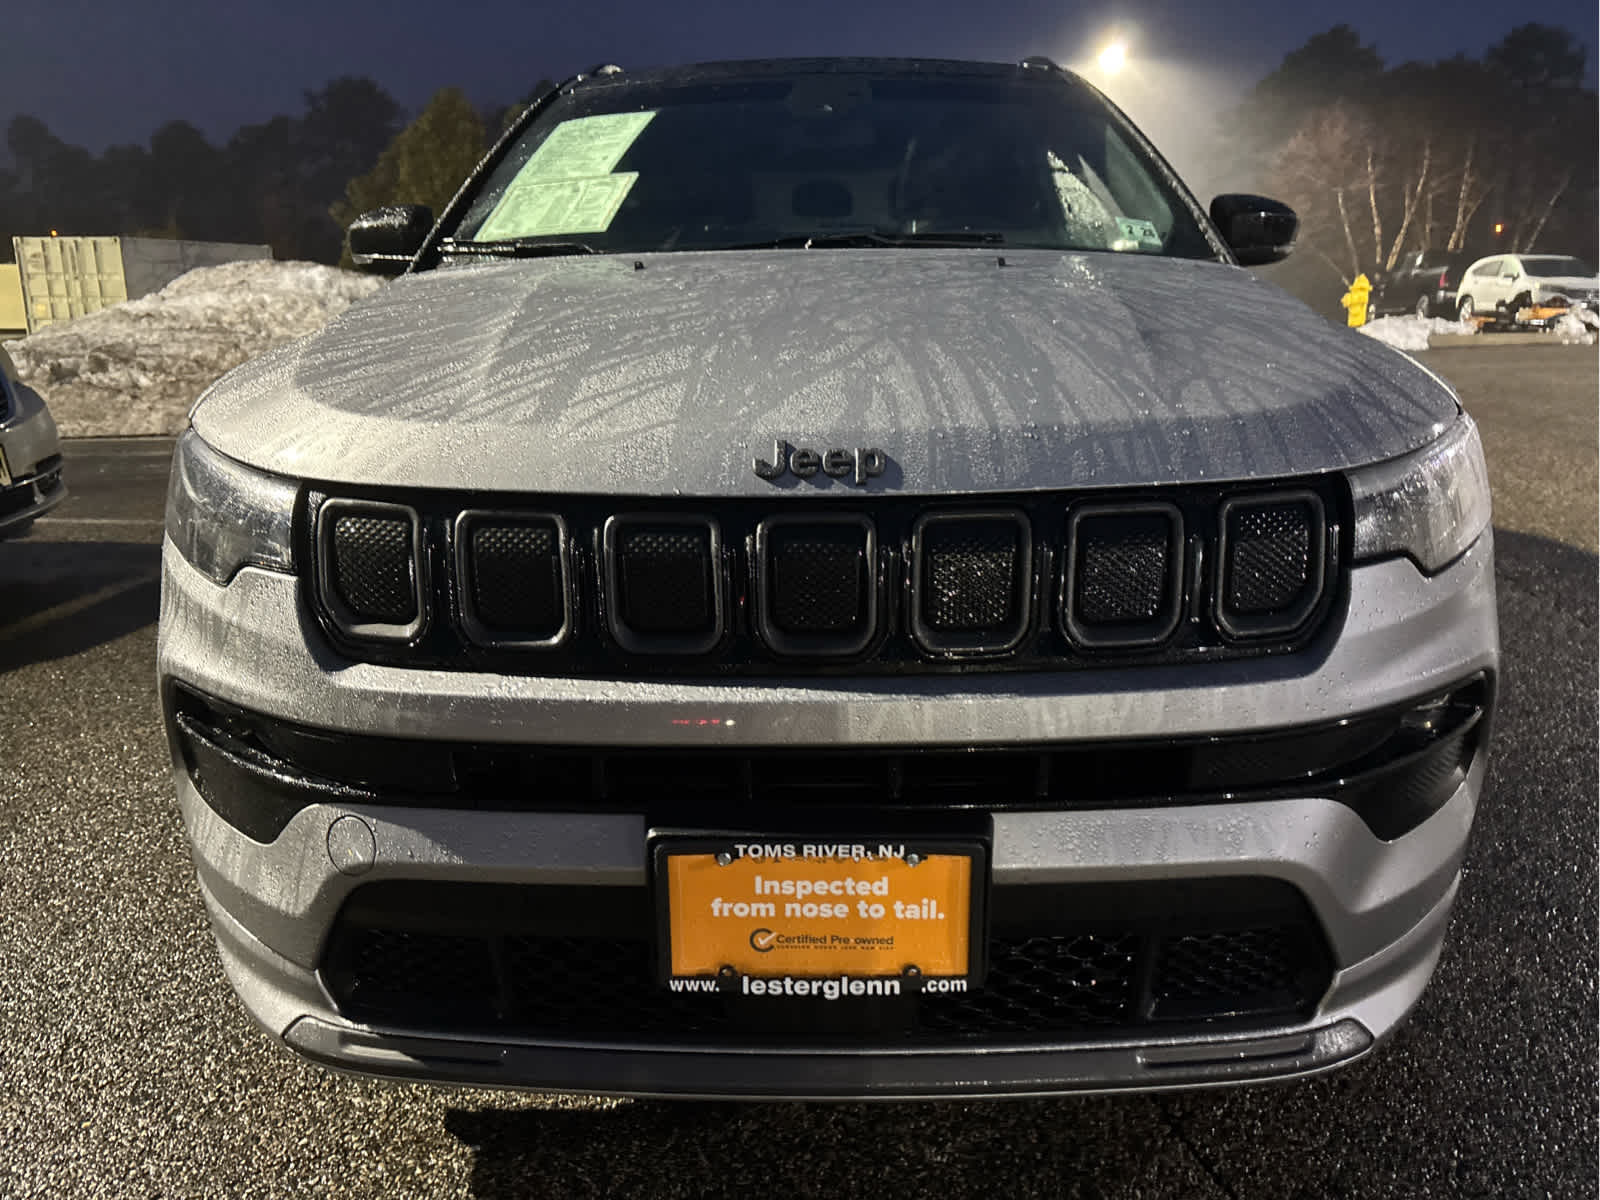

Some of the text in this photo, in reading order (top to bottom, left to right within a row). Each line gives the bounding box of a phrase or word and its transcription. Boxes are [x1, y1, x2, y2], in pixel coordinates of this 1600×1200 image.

[752, 440, 886, 485] Jeep
[734, 844, 905, 860] TOMS RIVER, NJ
[755, 875, 889, 900] Inspected
[711, 897, 945, 920] from nose to tail.
[776, 934, 827, 945] Certified
[669, 975, 968, 1001] www. lesterglenn .com
